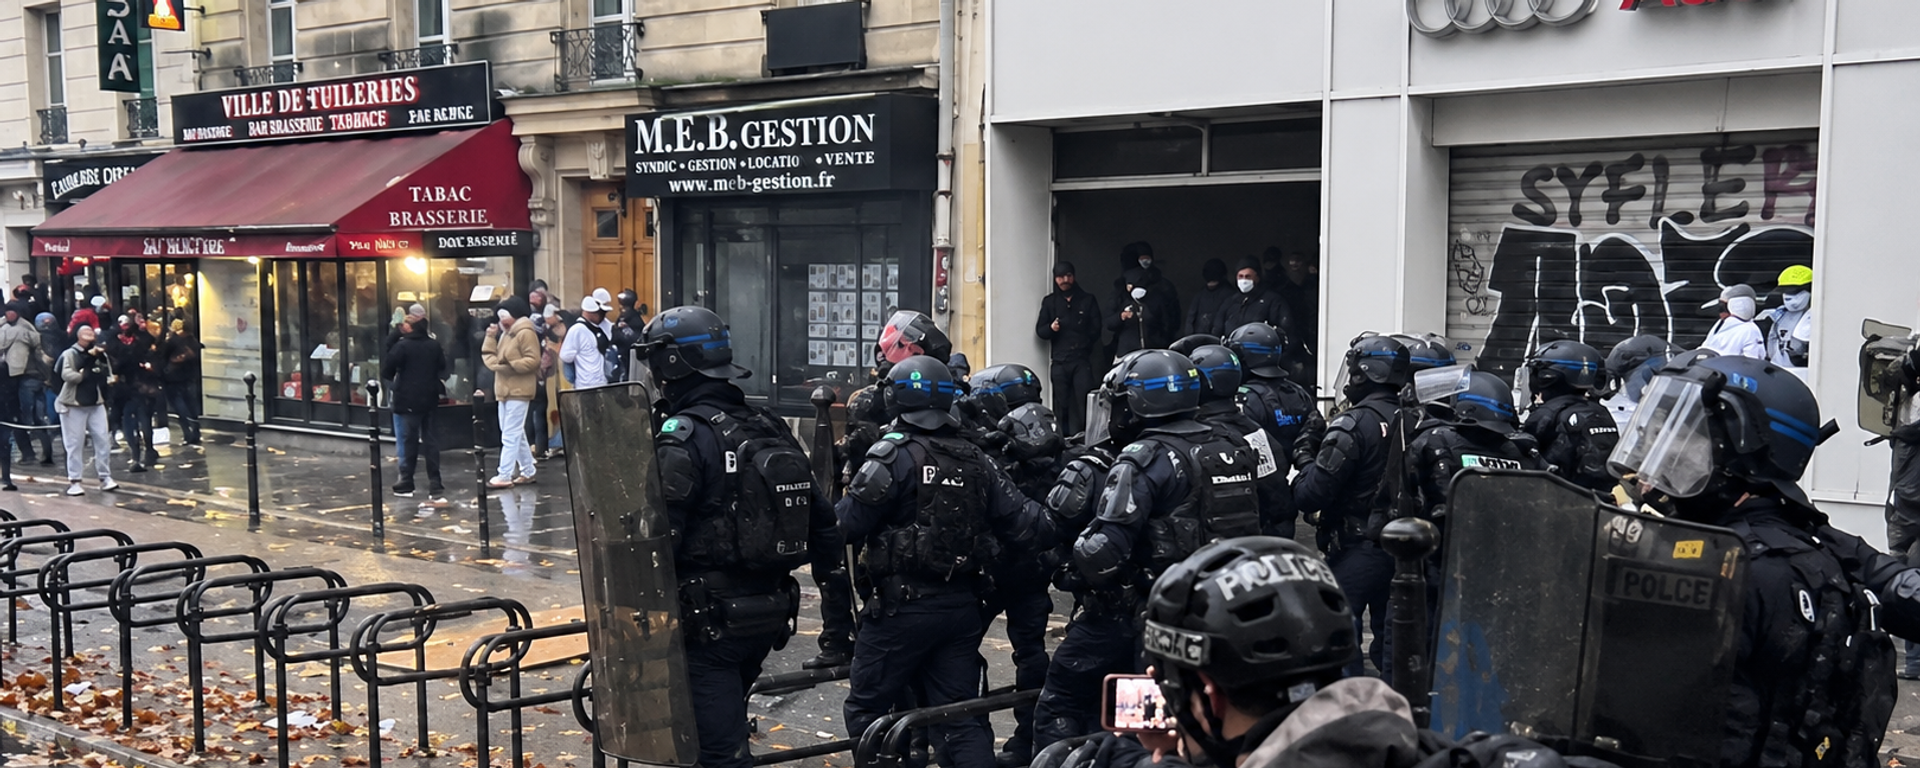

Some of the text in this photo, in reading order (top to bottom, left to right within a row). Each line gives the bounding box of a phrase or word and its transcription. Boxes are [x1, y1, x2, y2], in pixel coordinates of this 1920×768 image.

[221, 76, 417, 119] VILLE DE TUILERIES
[634, 113, 876, 154] M.E.B. GESTION
[635, 151, 875, 174] SYNDIC GESTION LOCATIO VENTE
[668, 171, 836, 193] www.meb-gestion.fr
[409, 186, 472, 203] TABAC
[389, 209, 488, 227] BRASSERIE
[1215, 553, 1340, 601] POLICE
